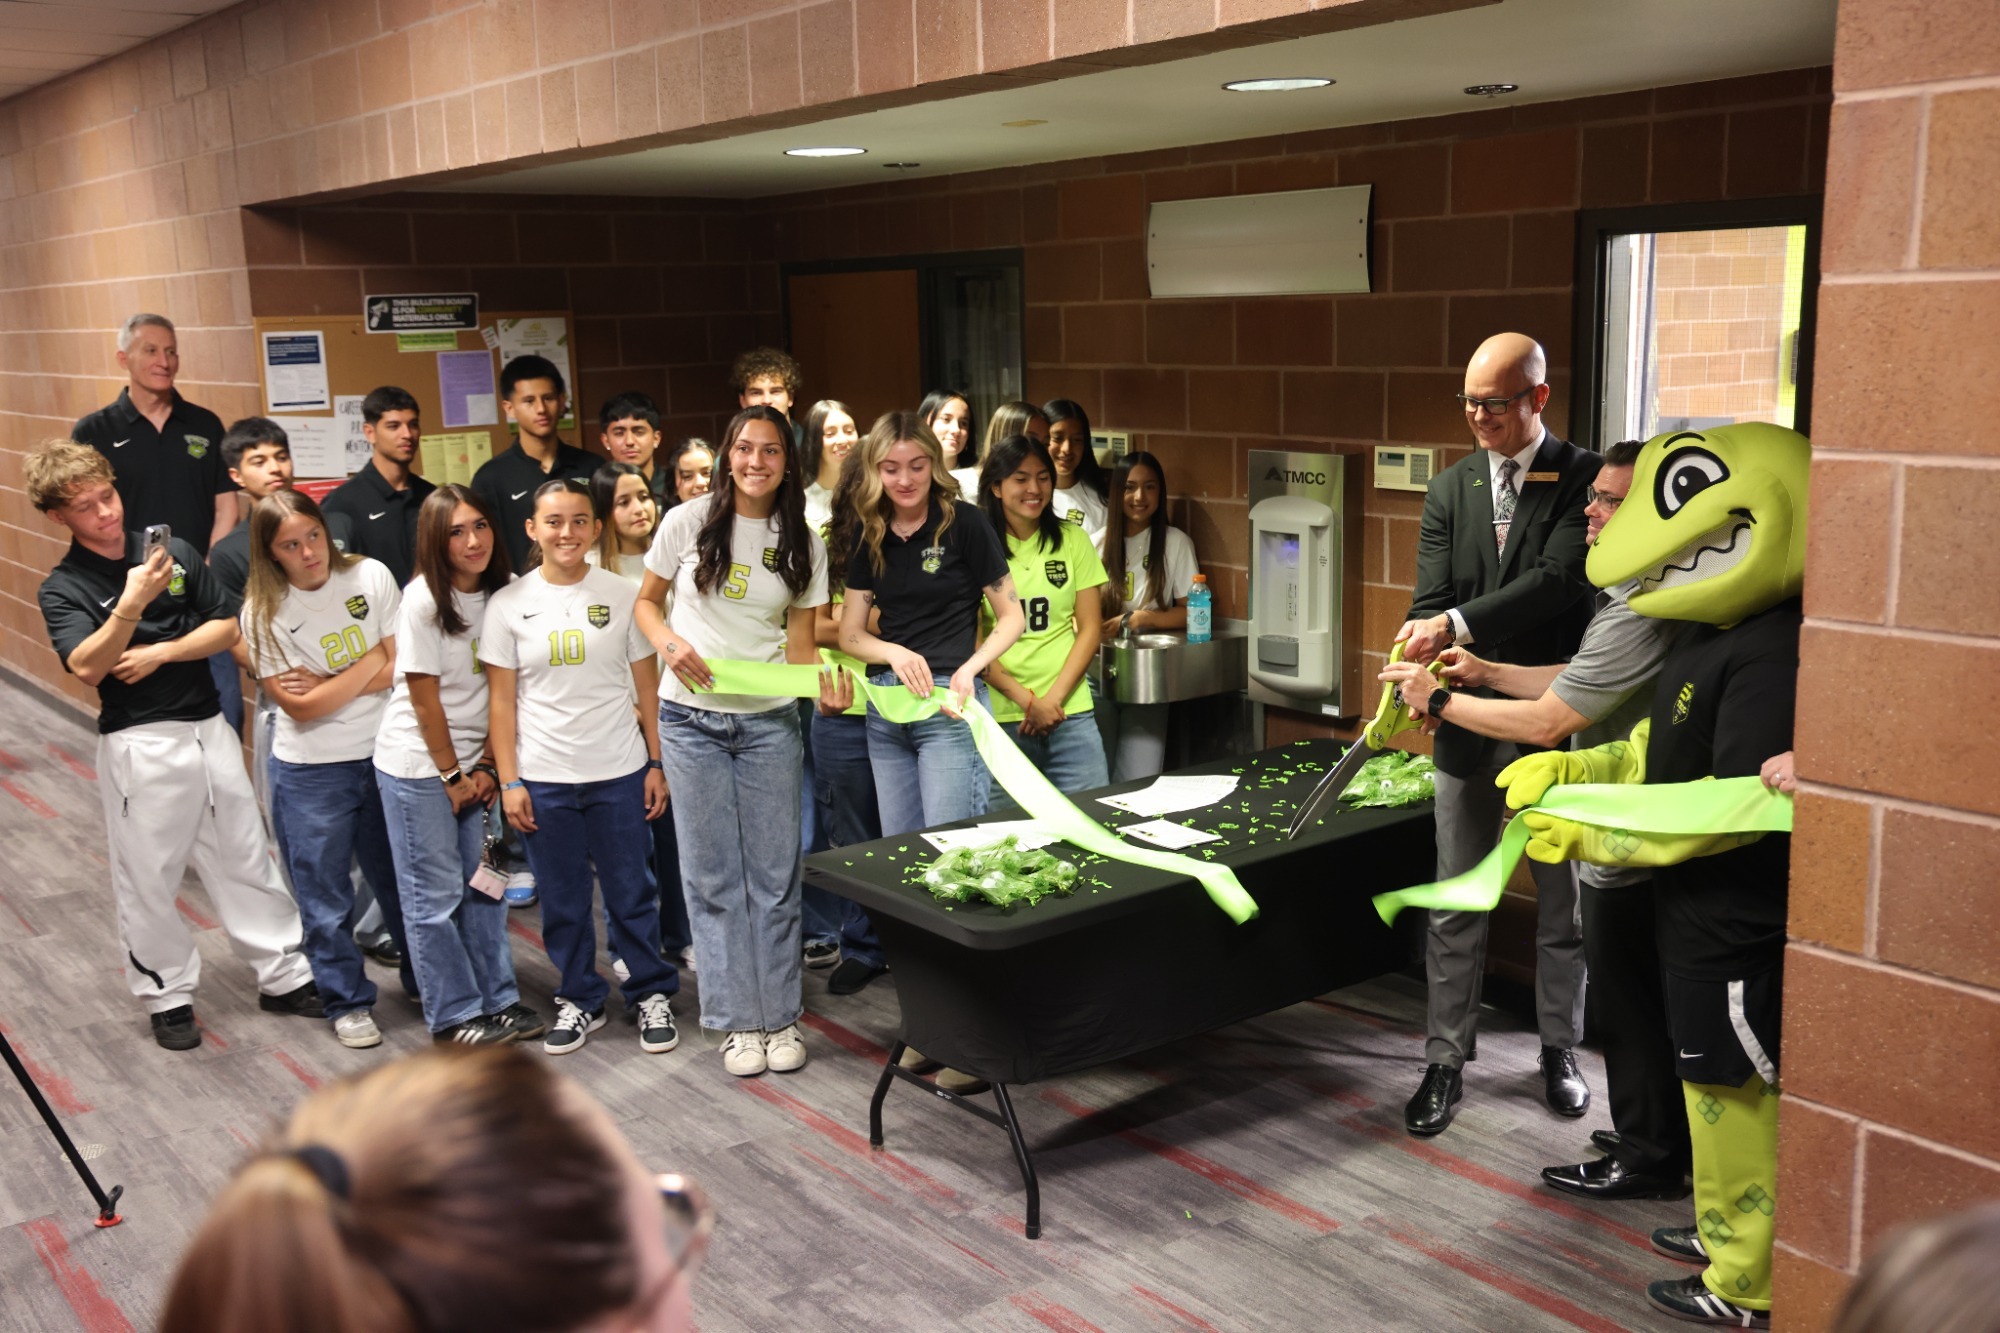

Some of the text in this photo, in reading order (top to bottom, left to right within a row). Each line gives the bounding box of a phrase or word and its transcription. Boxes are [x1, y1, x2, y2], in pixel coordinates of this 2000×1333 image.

[392, 314, 434, 322] MATERIALS
[410, 298, 445, 306] BULLETIN
[445, 297, 472, 305] BOARD
[1283, 470, 1326, 485] TMCC
[724, 562, 752, 600] 5
[1019, 597, 1049, 633] 8
[320, 624, 367, 669] 20
[548, 629, 585, 666] 10
